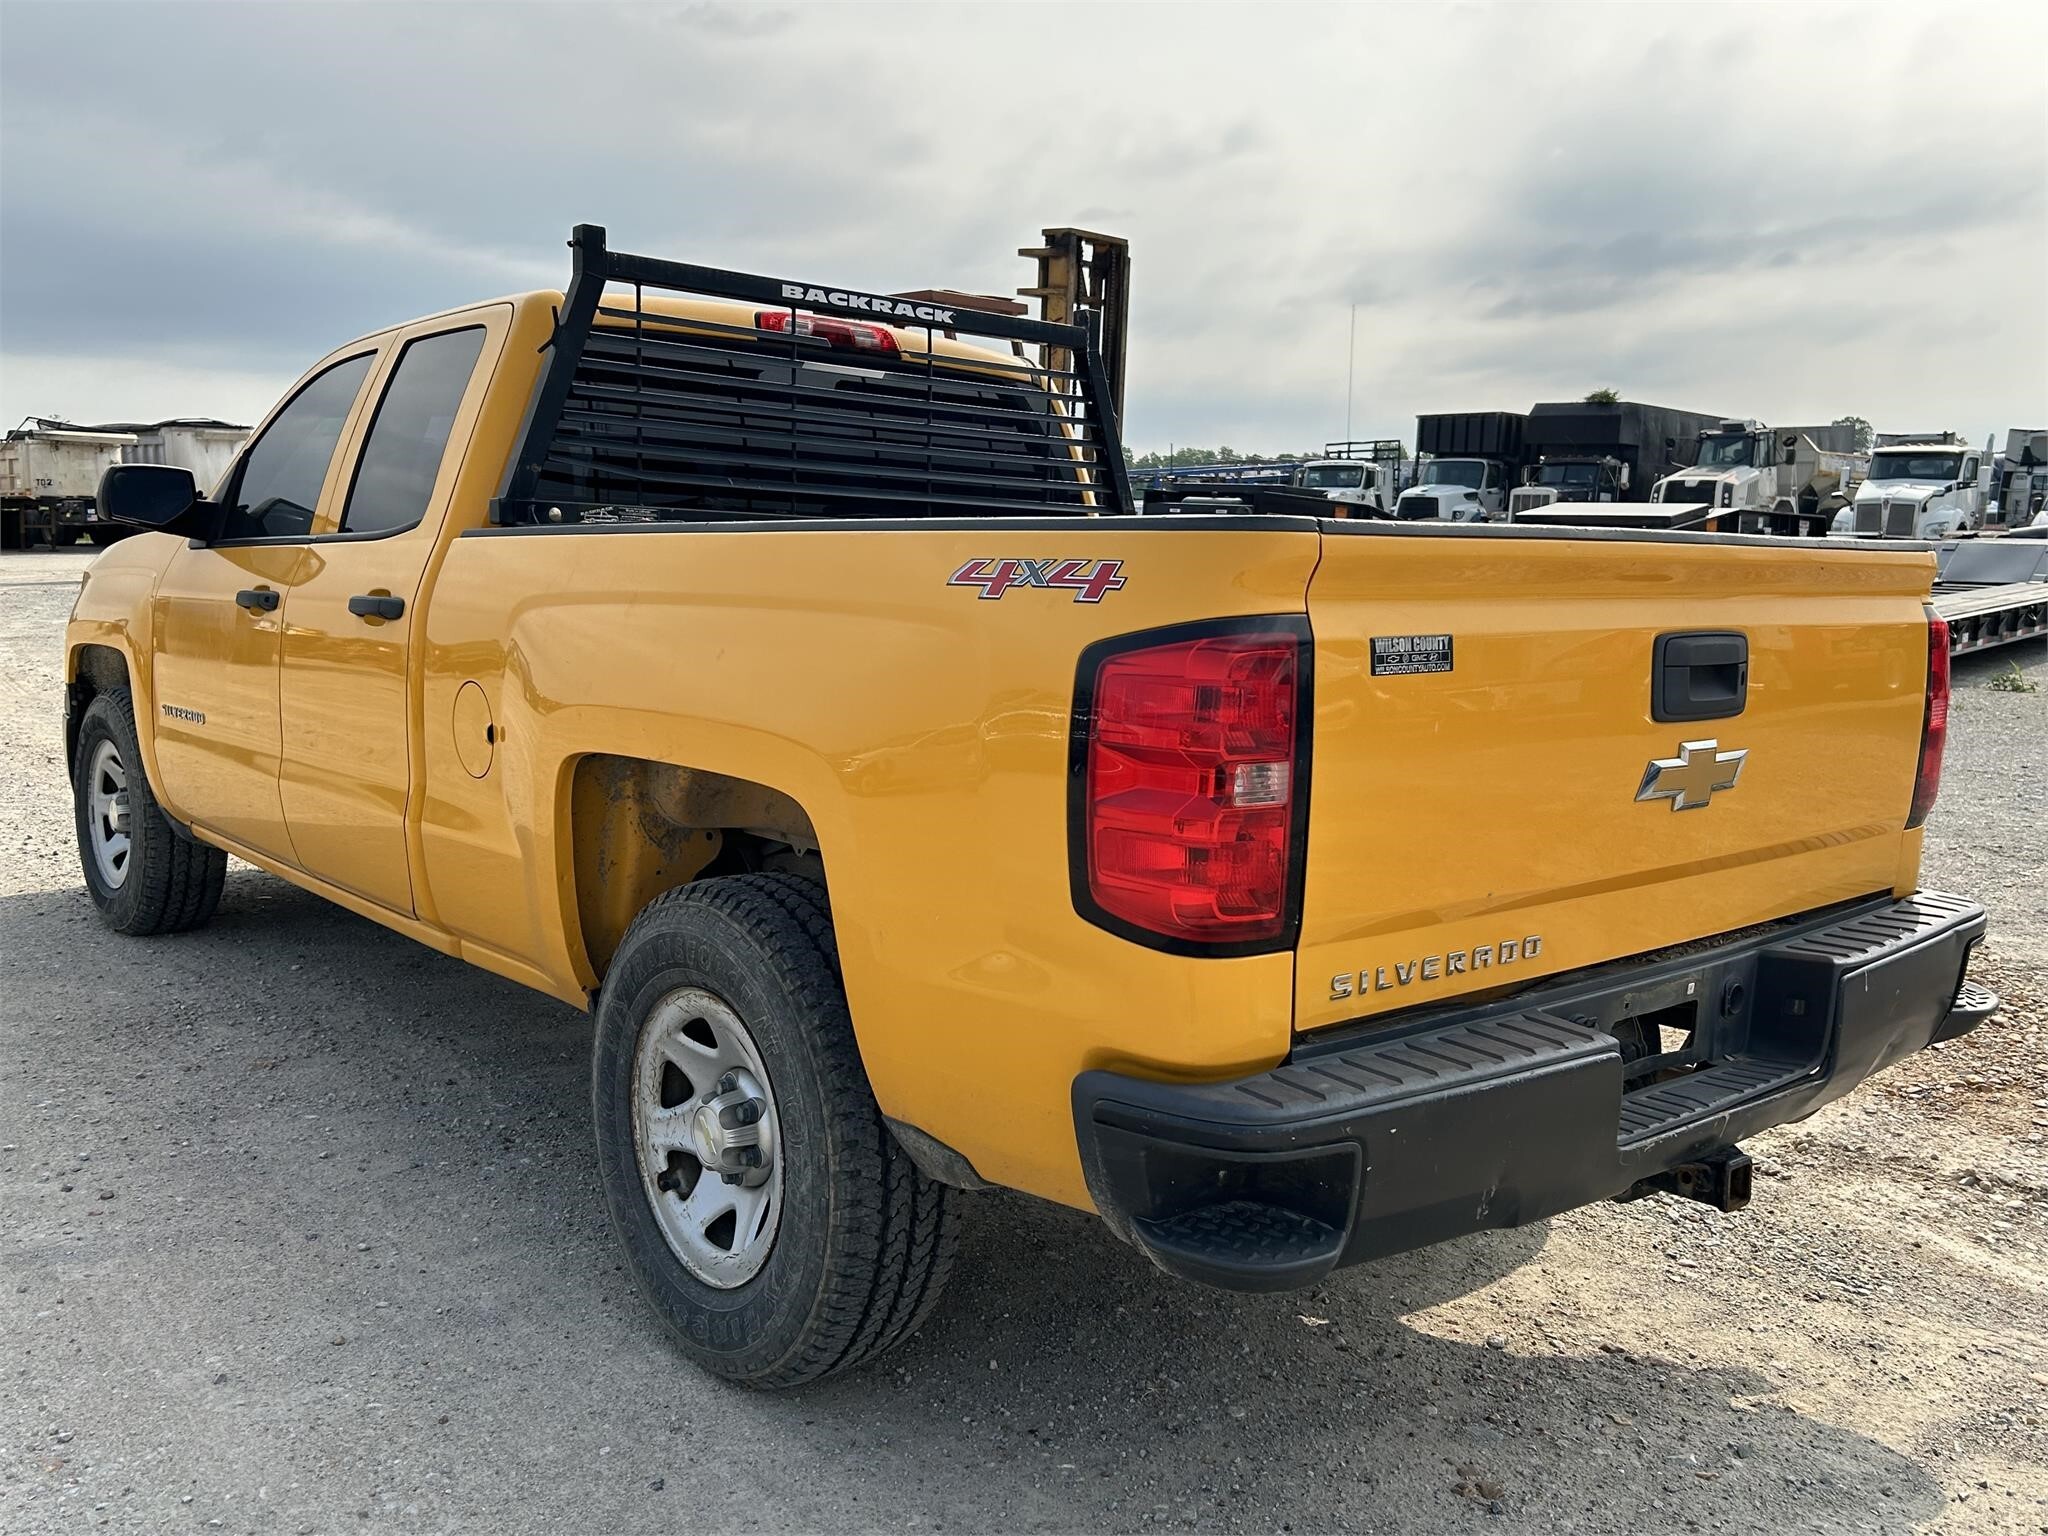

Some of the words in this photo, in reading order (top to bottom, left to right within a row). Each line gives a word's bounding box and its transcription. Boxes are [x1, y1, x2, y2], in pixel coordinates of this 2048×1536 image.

[781, 284, 955, 325] BACKRACK
[1375, 637, 1412, 653] WILSON
[1413, 636, 1449, 651] COUNTY
[1329, 935, 1543, 1000] SILVERADO
